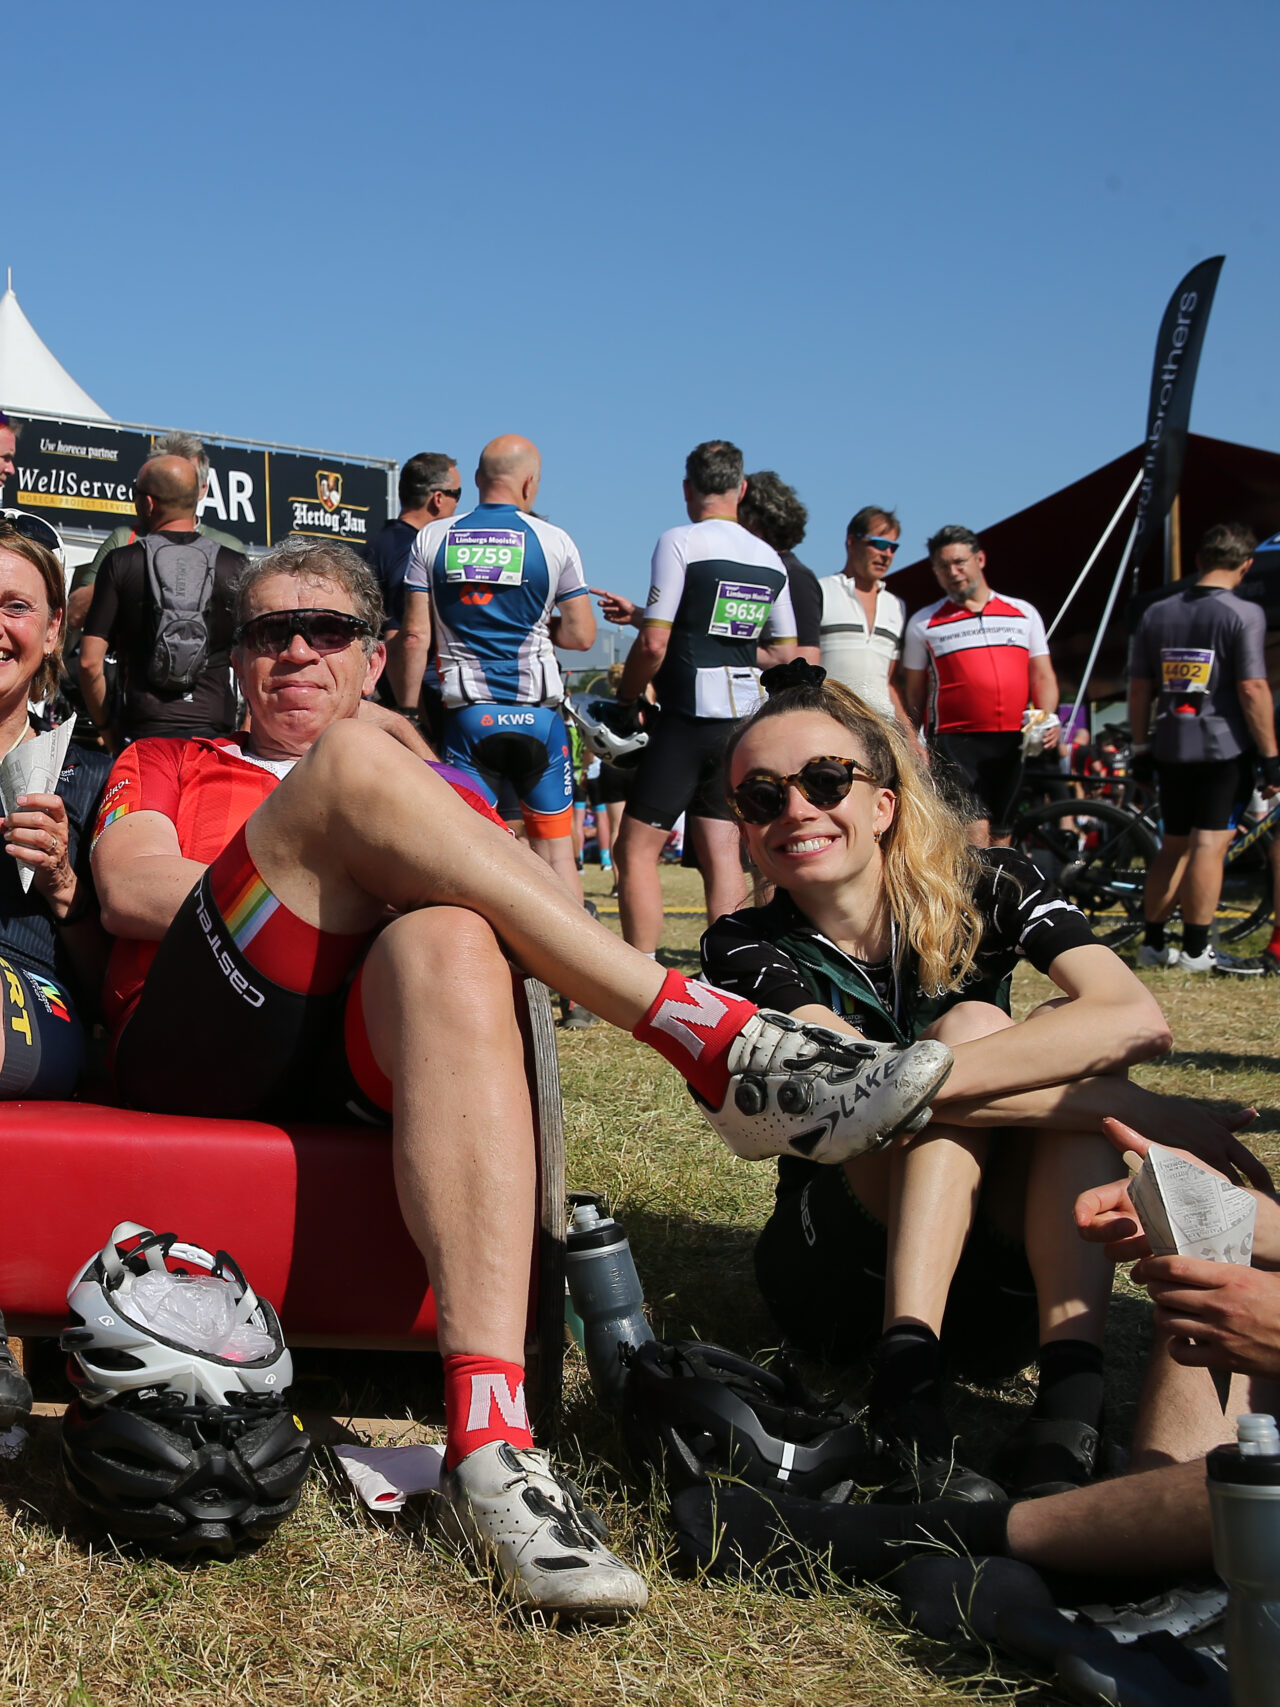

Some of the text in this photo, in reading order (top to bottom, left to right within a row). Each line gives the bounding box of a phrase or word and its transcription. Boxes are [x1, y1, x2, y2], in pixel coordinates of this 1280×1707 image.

[40, 438, 119, 461] Uw horeca partner
[17, 467, 134, 501] WellServe
[195, 466, 256, 523] AR
[292, 502, 367, 537] Hertog Jan
[456, 547, 512, 566] 9759
[724, 601, 766, 622] 9634
[497, 713, 535, 726] KWS
[563, 760, 572, 796] KWS
[839, 1055, 899, 1119] LAKE
